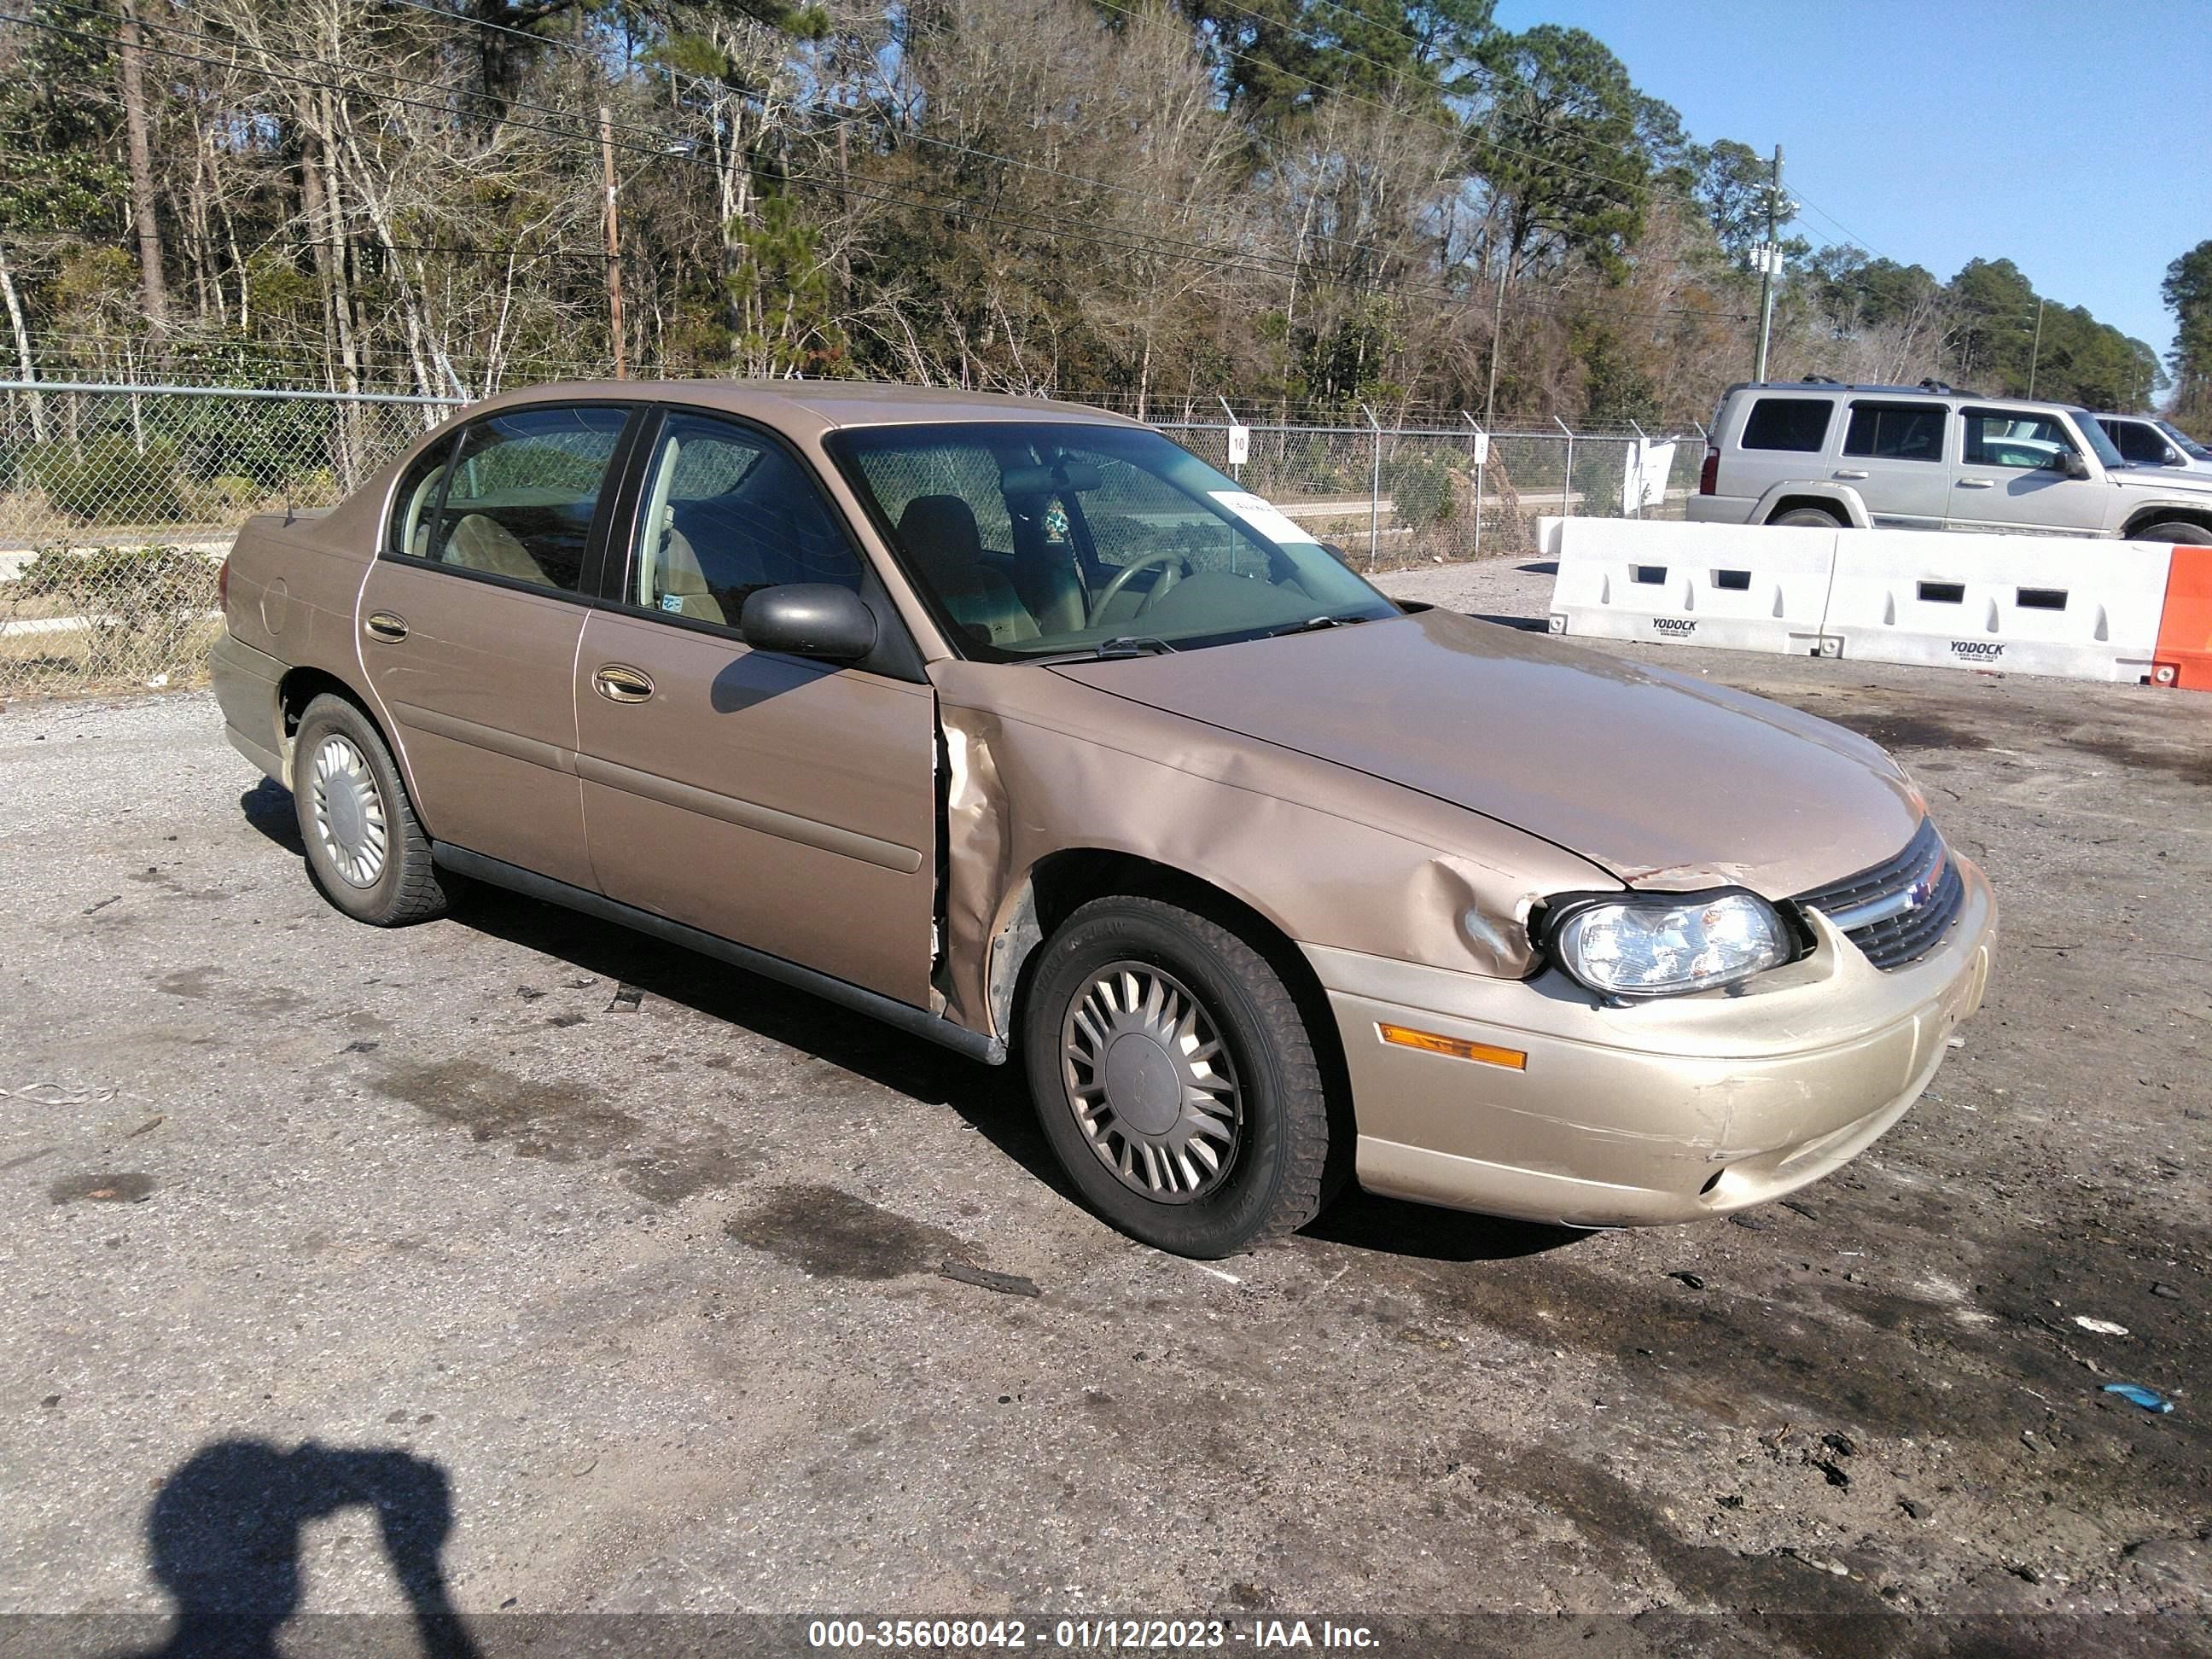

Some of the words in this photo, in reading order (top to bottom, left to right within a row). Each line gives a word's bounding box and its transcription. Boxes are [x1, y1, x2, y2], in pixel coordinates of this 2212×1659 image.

[1234, 437, 1244, 451] 10
[1653, 617, 1697, 631] YODOCK
[1950, 641, 2005, 655] YODOCK
